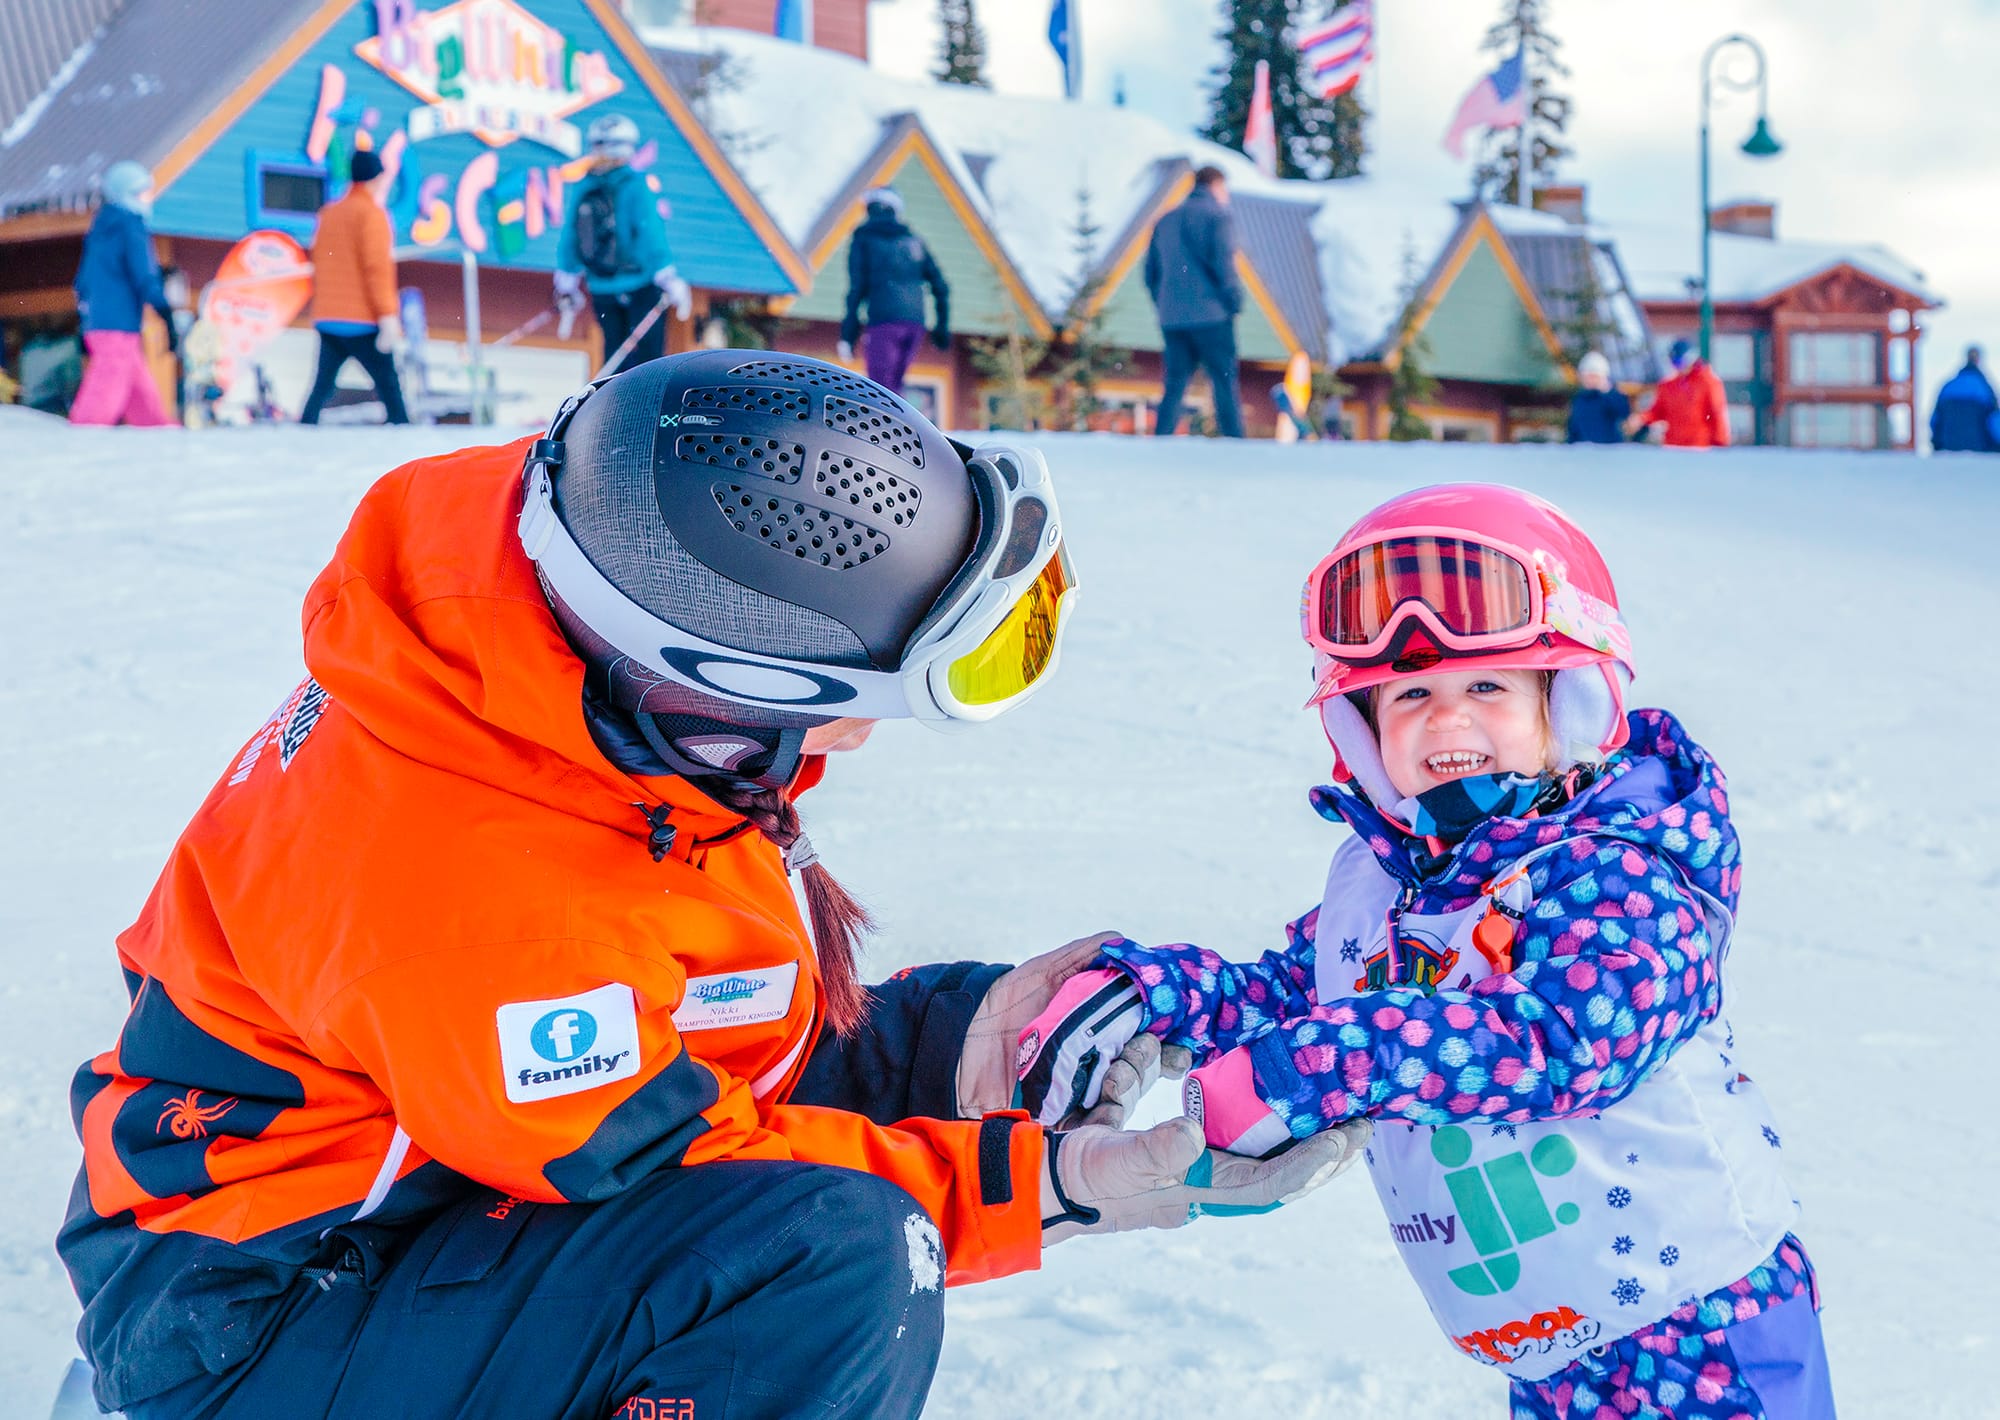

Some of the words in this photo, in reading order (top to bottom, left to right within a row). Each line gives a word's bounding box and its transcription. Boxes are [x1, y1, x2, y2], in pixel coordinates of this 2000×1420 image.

[710, 1005, 739, 1016] Nikki
[718, 1014, 746, 1025] UNITED
[747, 1009, 784, 1021] KINGDOM
